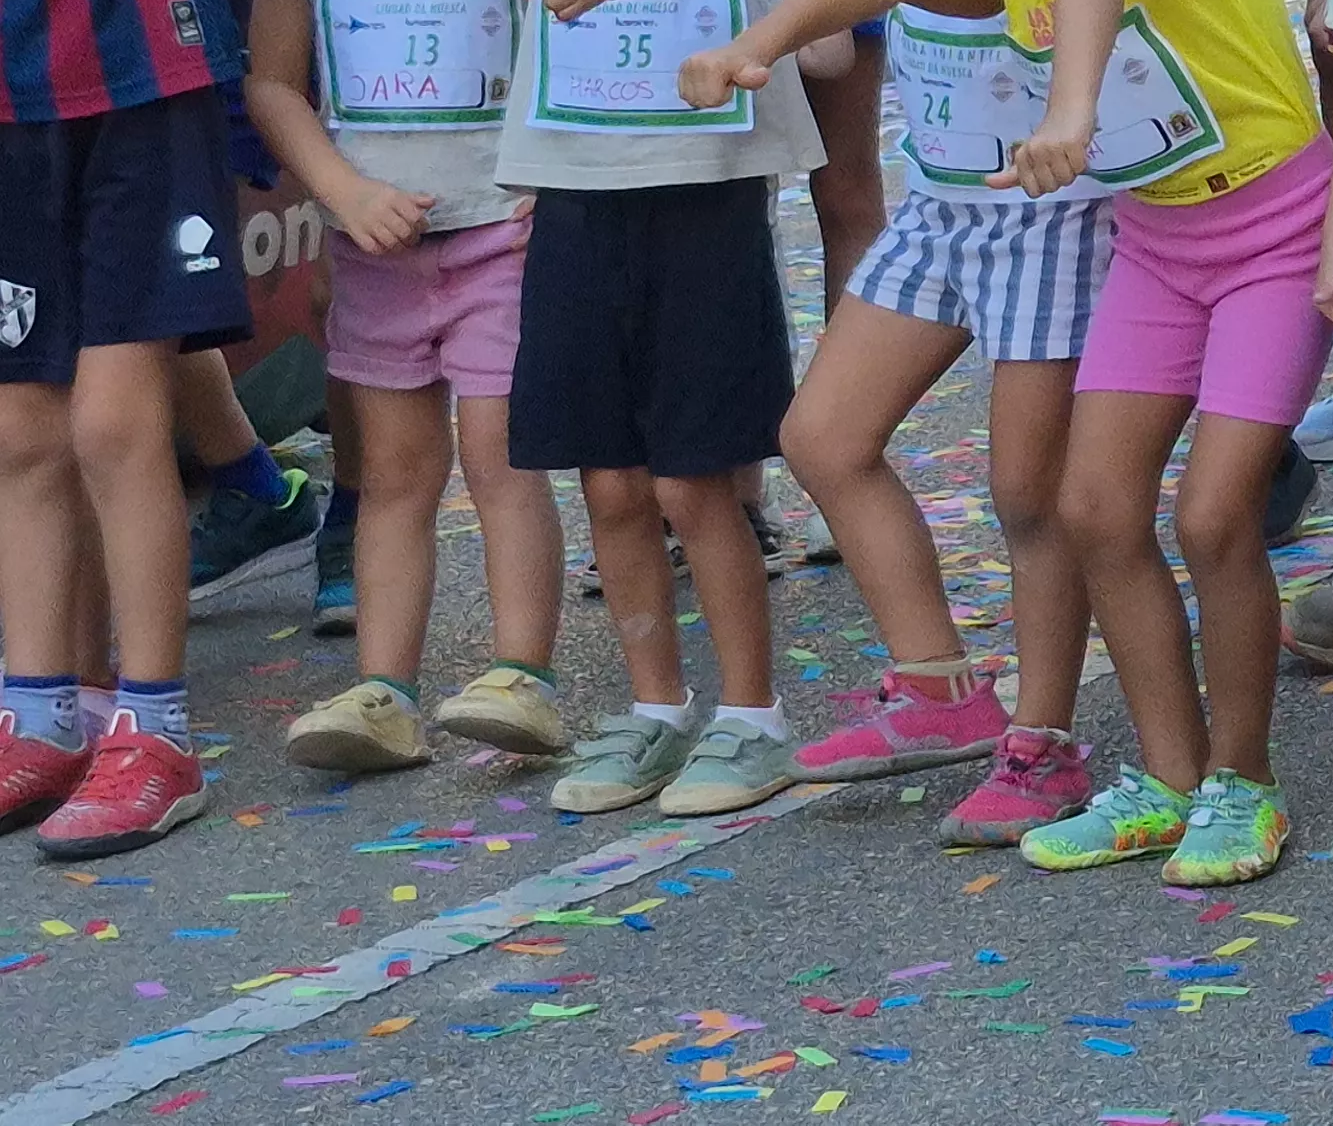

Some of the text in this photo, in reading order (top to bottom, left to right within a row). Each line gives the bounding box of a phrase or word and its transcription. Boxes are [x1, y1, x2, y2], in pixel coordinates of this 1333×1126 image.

[404, 33, 440, 67] 13
[615, 33, 653, 70] 35
[922, 91, 953, 129] 24
